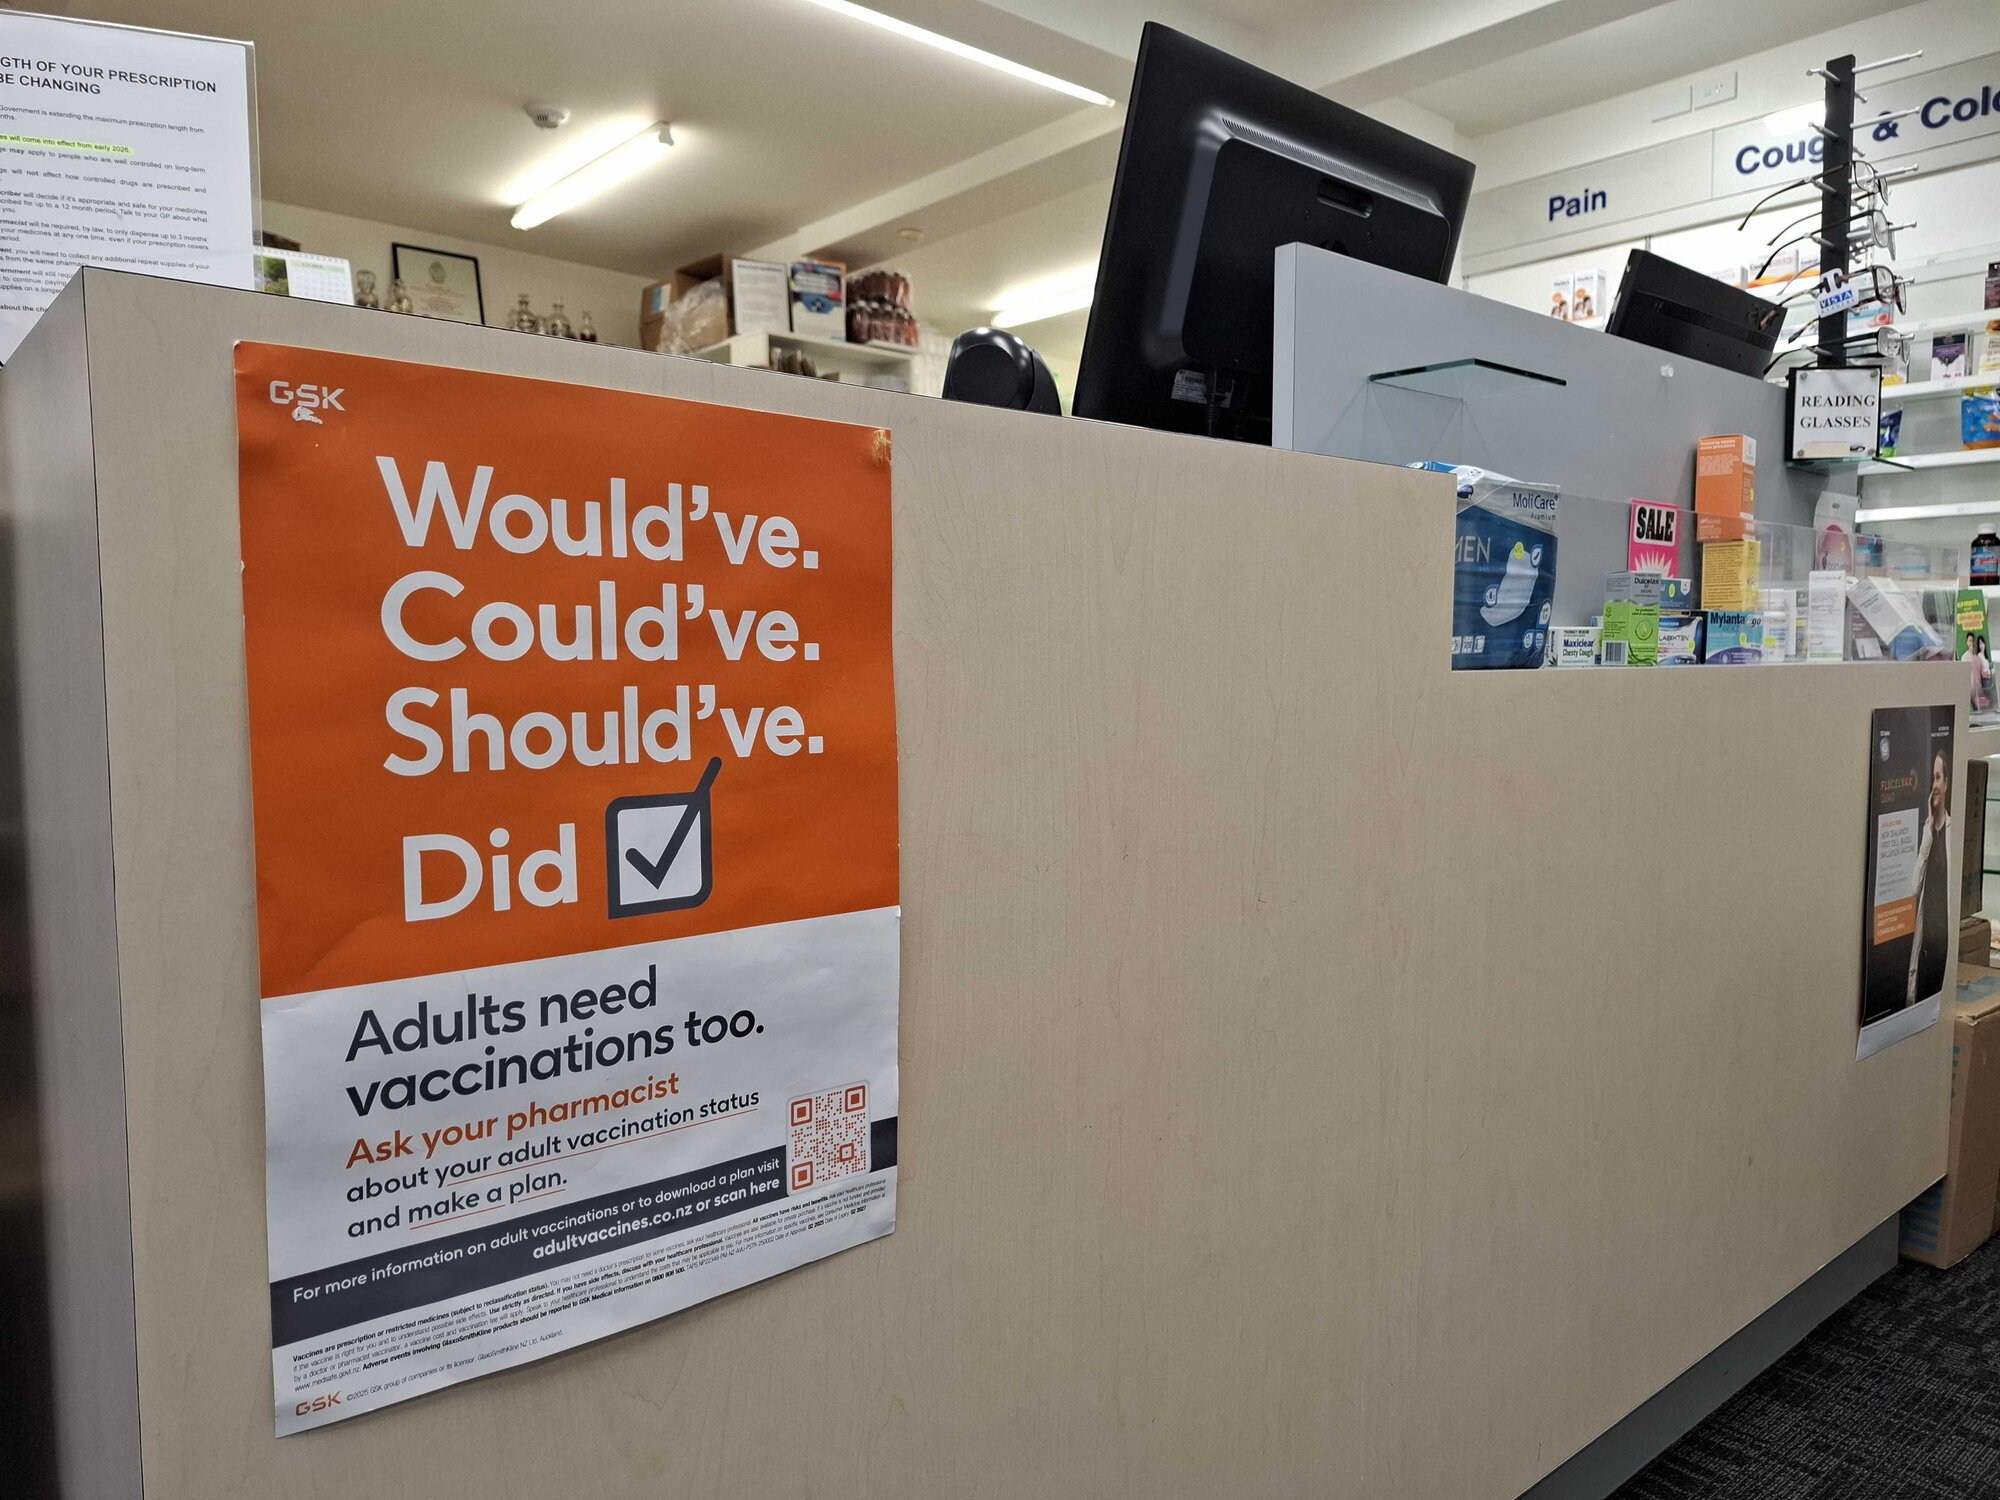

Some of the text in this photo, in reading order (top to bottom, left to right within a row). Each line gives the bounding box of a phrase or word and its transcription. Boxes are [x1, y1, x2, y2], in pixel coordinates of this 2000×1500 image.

[19, 75, 100, 94] CHANGING
[36, 60, 56, 72] OF
[60, 63, 104, 78] YOUR
[108, 69, 216, 93] PRESCRIPTION
[48, 111, 82, 121] extending
[94, 116, 127, 124] maximum
[128, 120, 167, 129] prescription
[167, 124, 188, 132] length
[42, 137, 55, 145] into
[76, 141, 93, 149] from
[112, 145, 129, 153] 2026.
[1736, 135, 1825, 175] Coug
[1872, 109, 1900, 142] &
[27, 149, 46, 157] apply
[58, 152, 81, 160] people
[129, 160, 161, 169] controlled
[174, 164, 206, 173] long-term
[83, 176, 116, 184] controlled
[119, 179, 138, 187] drugs
[156, 183, 191, 192] prescribed
[1548, 188, 1607, 222] Pain
[1820, 289, 1853, 309] VISTA
[269, 380, 346, 412] GSK
[1801, 394, 1876, 408] READING
[1800, 415, 1872, 429] GLASSES
[375, 455, 819, 569] Would've.
[1512, 493, 1556, 510] MoliCare
[1636, 506, 1675, 542] SALE
[1634, 577, 1659, 586] Dulcolax
[381, 570, 820, 662] Could've.
[1710, 611, 1745, 628] Mylanta
[1562, 649, 1594, 658] Chesty Cough
[1563, 638, 1594, 648] Maxiclear
[384, 684, 823, 777] Should've.
[403, 823, 578, 922] Did
[345, 963, 656, 1062] Adults need
[345, 1009, 764, 1117] vaccinations too.
[345, 1072, 679, 1169] Ask your pharmacist
[346, 1091, 759, 1202] about your adult vaccination status
[347, 1172, 567, 1237] and make a plan.
[533, 1178, 779, 1259] adultvaccines.co.nz or scan here
[293, 1158, 779, 1303] For more information on adult vaccinations or to download a plan visit
[489, 1307, 500, 1315] Use
[501, 1300, 521, 1311] strictly
[531, 1289, 554, 1302] directed.
[562, 1285, 572, 1293] you
[588, 1277, 599, 1285] side
[621, 1264, 641, 1274] discuss
[642, 1260, 653, 1268] with
[654, 1256, 666, 1265] your
[666, 1247, 692, 1259] healthcare
[694, 1237, 723, 1252] professional.
[292, 1348, 323, 1362] Vaccines
[324, 1344, 335, 1353] are
[336, 1332, 376, 1350] prescription
[385, 1320, 416, 1334] restricted
[417, 1312, 449, 1325] medicines
[450, 1304, 475, 1318] (subject
[483, 1289, 527, 1307] reclassification
[362, 1358, 388, 1370] Adverse
[389, 1351, 411, 1362] events
[412, 1342, 441, 1355] involving
[441, 1328, 491, 1347] GlaxoSmithKline
[492, 1320, 518, 1333] products
[519, 1312, 539, 1324] should
[548, 1302, 571, 1315] reported
[578, 1296, 590, 1305] GSK
[591, 1289, 612, 1301] Medical
[613, 1281, 644, 1294] Information
[651, 1273, 664, 1282] 0800
[665, 1269, 674, 1277] 808
[370, 1385, 382, 1393] GSK
[383, 1379, 400, 1390] group
[401, 1376, 407, 1384] of
[408, 1367, 438, 1381] companies
[477, 1344, 519, 1360] GlaxoSmithKline
[519, 1339, 528, 1347] NZ
[295, 1390, 342, 1417] GSK
